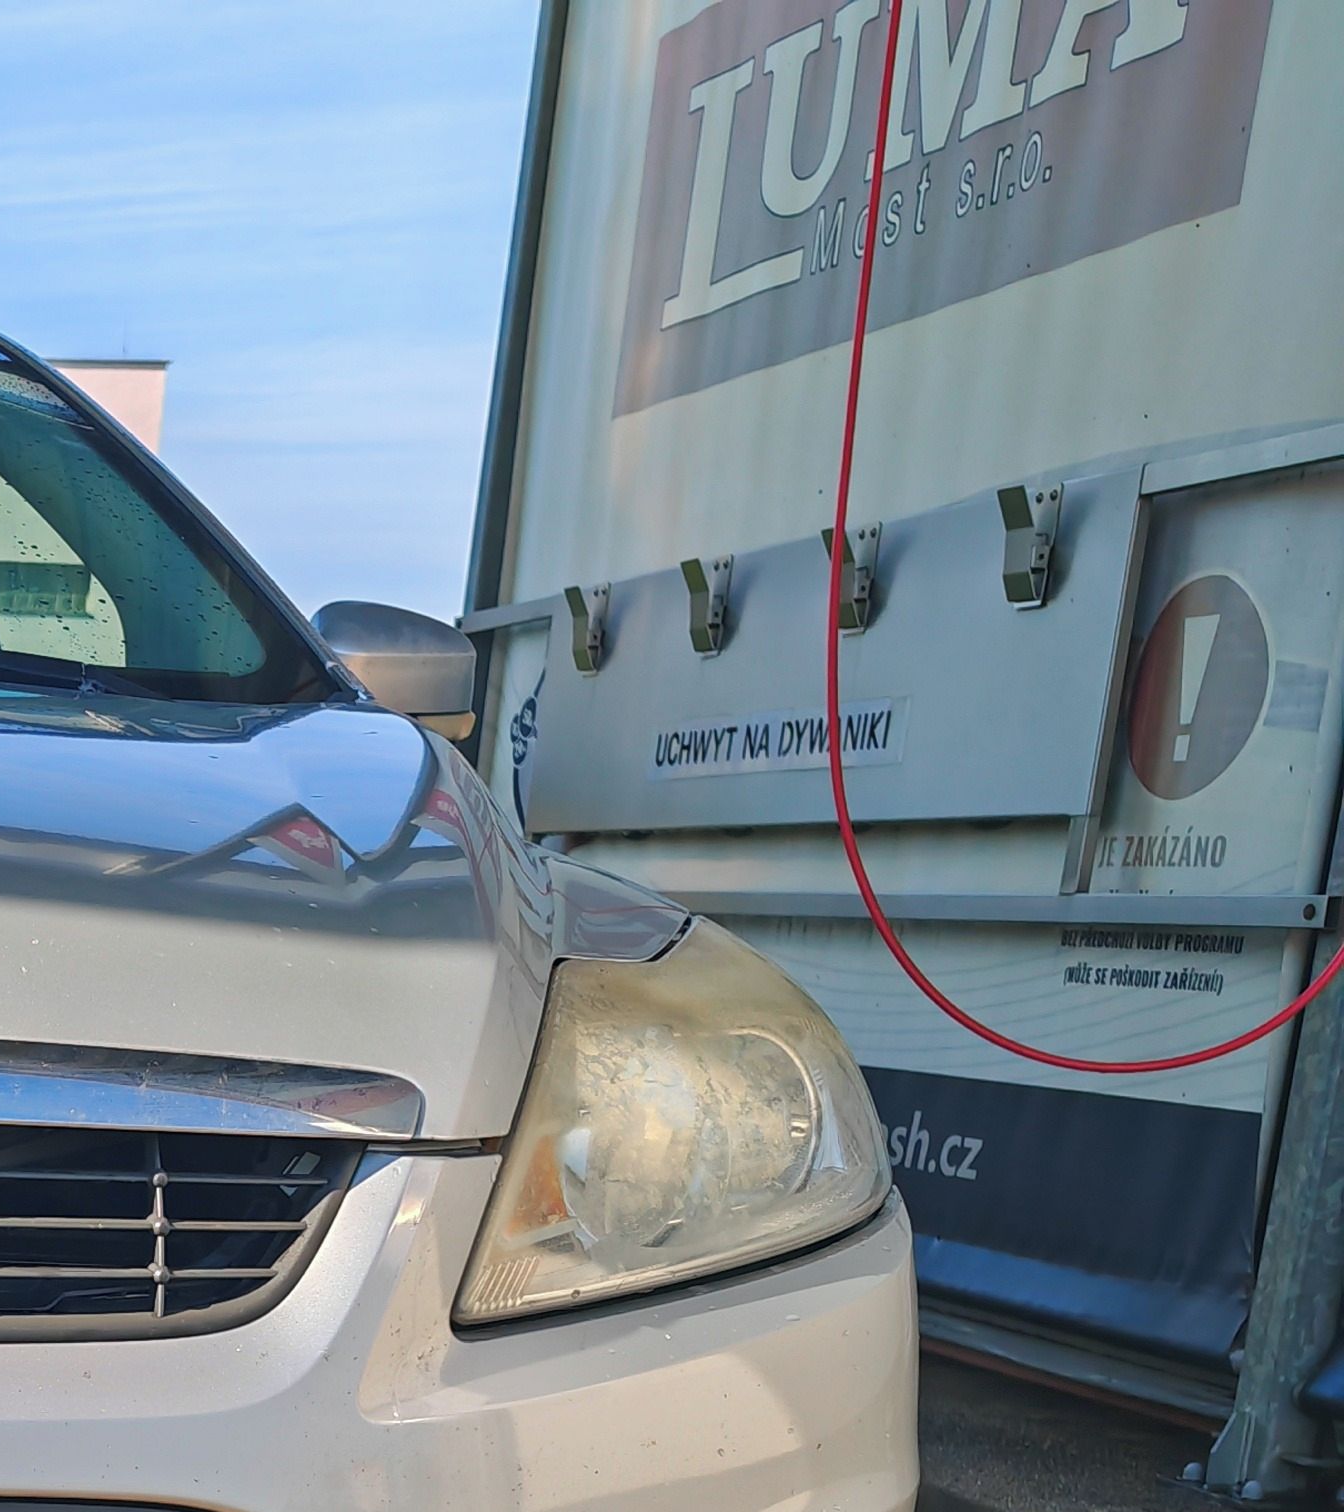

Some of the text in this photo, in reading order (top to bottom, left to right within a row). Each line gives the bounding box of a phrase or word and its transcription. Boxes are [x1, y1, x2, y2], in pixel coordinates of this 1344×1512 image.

[955, 130, 1053, 219] s.r.o.
[655, 727, 738, 767] UCHWYT
[742, 722, 770, 760] NA
[1098, 826, 1227, 868] JE ZAKÁZÁNO
[1136, 931, 1170, 951] VOLBY
[1174, 933, 1245, 954] PROGRAMU
[1094, 967, 1108, 985] SE
[1110, 964, 1161, 989] POŠKODIT
